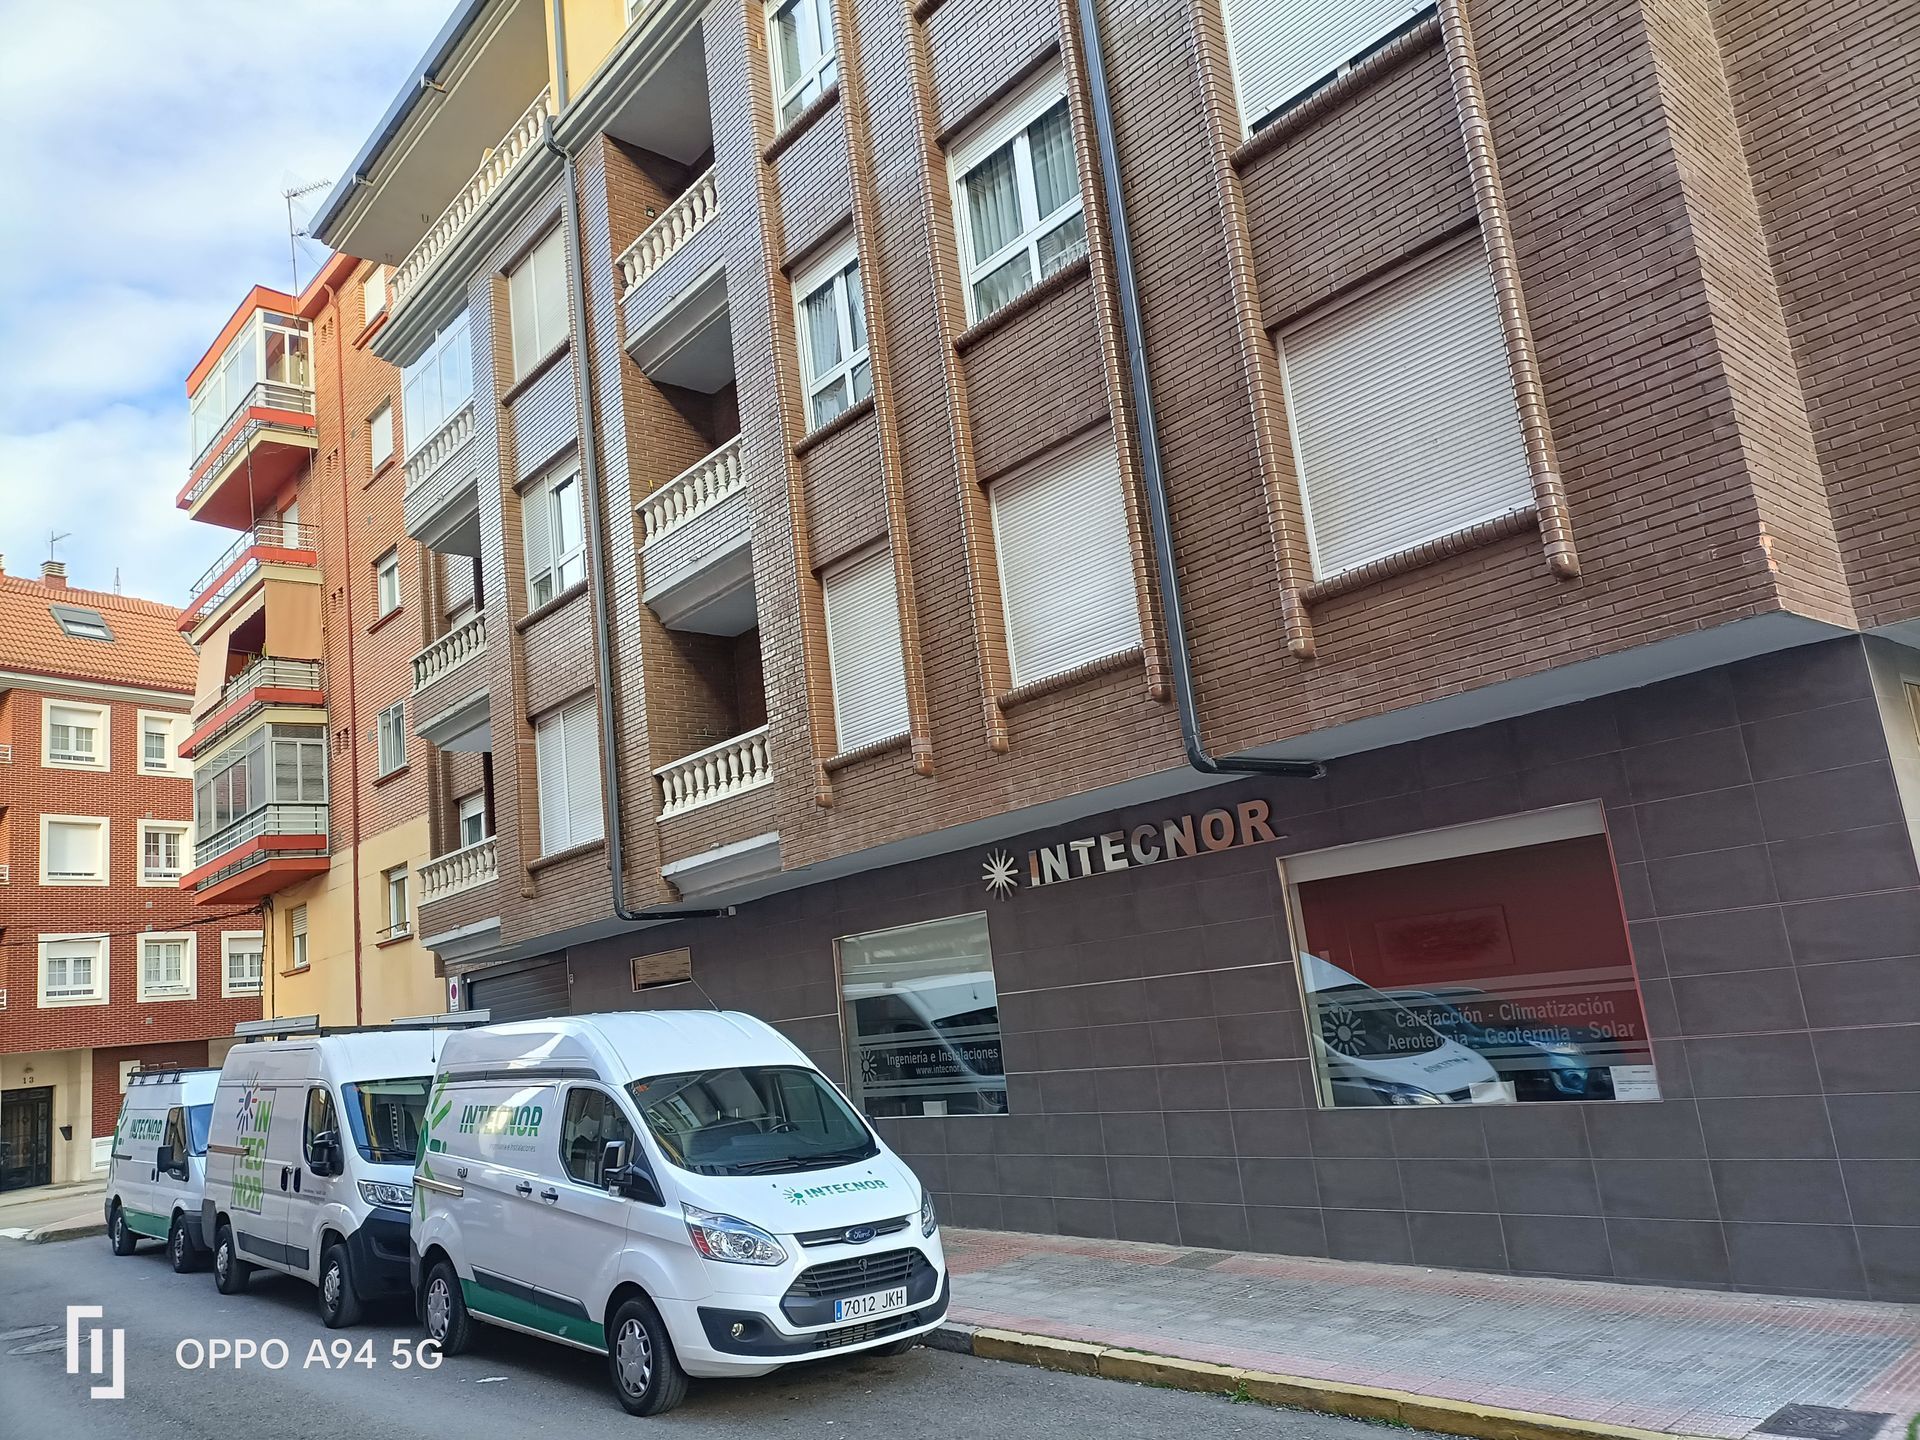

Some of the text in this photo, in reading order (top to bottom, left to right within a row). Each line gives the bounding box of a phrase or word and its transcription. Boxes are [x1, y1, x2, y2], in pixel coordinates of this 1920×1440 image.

[1028, 799, 1277, 886] INTECNOR
[1395, 1006, 1482, 1029] Calefacción
[1499, 997, 1615, 1022] Climatización
[1485, 1023, 1571, 1045] Geotermia
[1590, 1020, 1636, 1040] Solar
[886, 1047, 999, 1068] Ingeniería e Instalaciones
[23, 1076, 34, 1085] 13
[253, 1100, 272, 1133] IN
[459, 1104, 543, 1136] INTECNOR
[239, 1137, 266, 1171] TEC
[233, 1174, 264, 1209] NOR
[805, 1179, 888, 1198] INTECNOR
[853, 1229, 871, 1239] Ford
[844, 1290, 903, 1318] 7012 JKH
